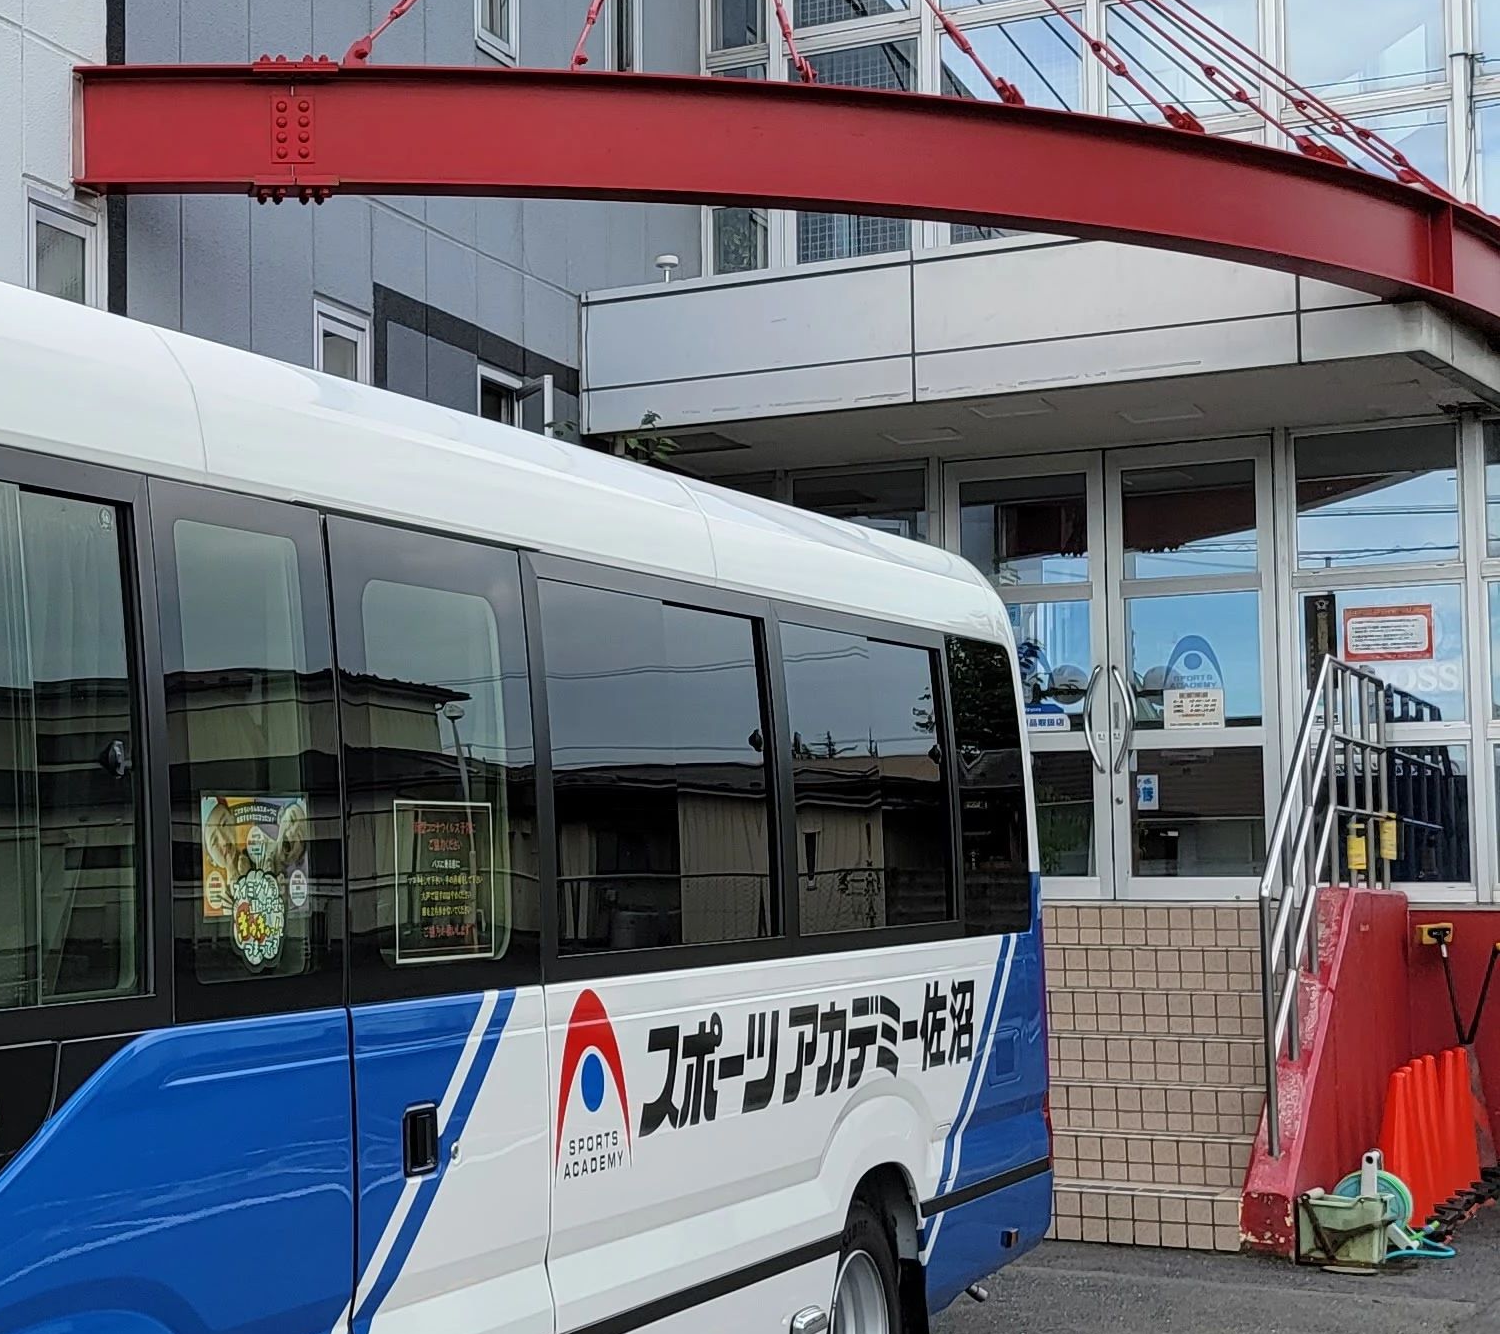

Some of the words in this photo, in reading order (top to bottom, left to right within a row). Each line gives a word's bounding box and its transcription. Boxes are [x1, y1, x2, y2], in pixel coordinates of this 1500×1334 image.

[1026, 717, 1065, 727] 品取扱店
[569, 1131, 619, 1156] SPORTS
[563, 1151, 624, 1180] ACADEMY
